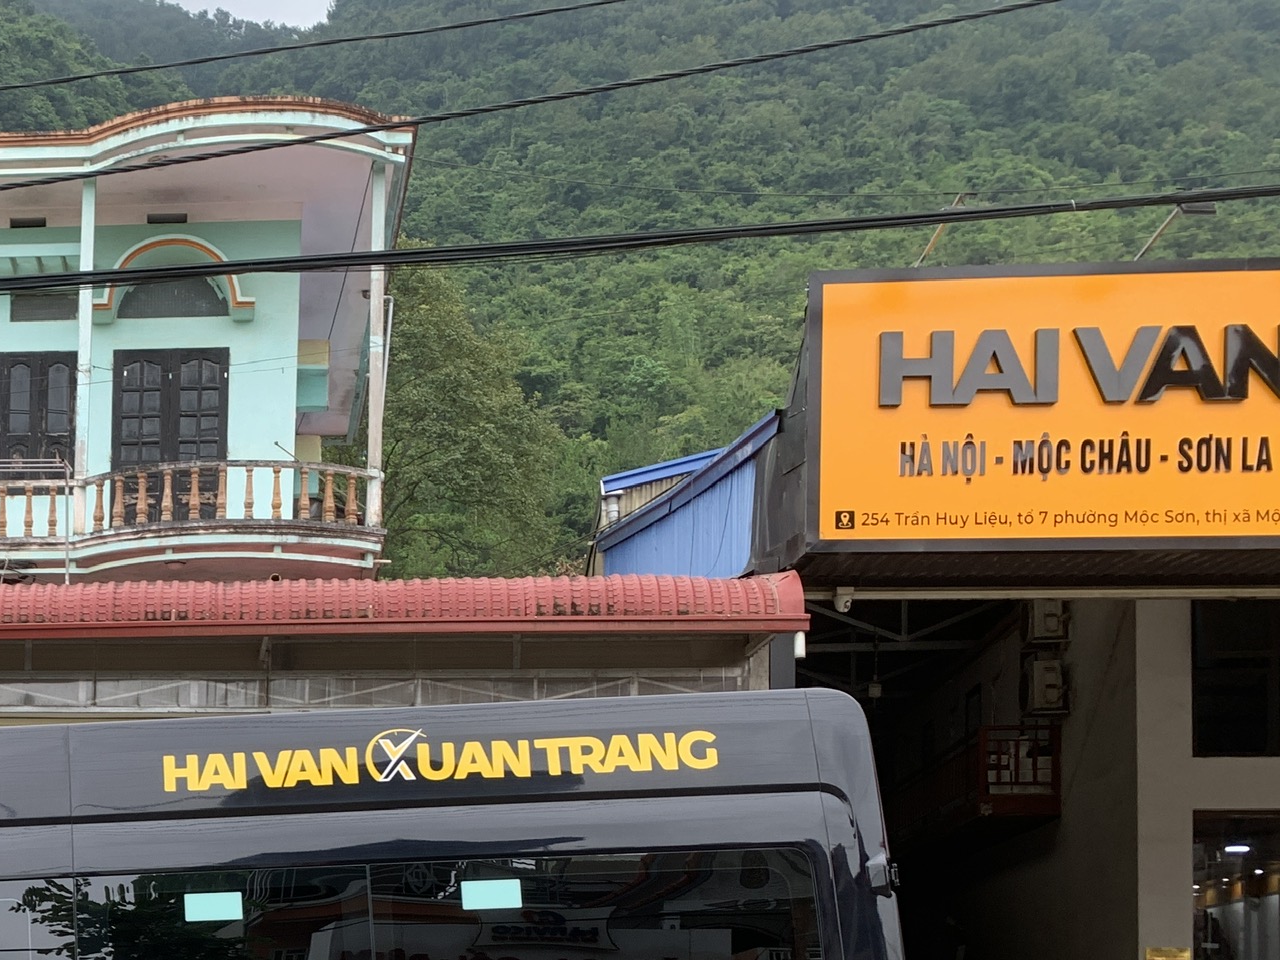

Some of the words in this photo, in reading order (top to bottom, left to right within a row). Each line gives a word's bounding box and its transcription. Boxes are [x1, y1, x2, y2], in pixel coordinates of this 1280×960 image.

[877, 328, 1061, 408] HAI
[1071, 323, 1280, 406] VAN
[899, 434, 933, 476] HÀ
[941, 433, 986, 484] NỘI
[1012, 432, 1072, 481] MỘC
[1080, 431, 1151, 474] CHÂU
[1177, 434, 1233, 473] SƠN
[1241, 436, 1274, 472] LA
[861, 512, 890, 526] 254
[895, 511, 930, 526] Trần
[936, 511, 969, 528] Huy
[974, 511, 1013, 528] Liệu,
[1017, 508, 1034, 525] tổ
[1038, 511, 1049, 525] 7
[1053, 509, 1118, 527] phường
[1124, 510, 1159, 526] Mộc
[1164, 509, 1200, 526] Sơn,
[1205, 509, 1227, 525] thị
[1232, 508, 1251, 523] xã
[163, 754, 246, 792] HAI
[252, 746, 359, 788] VAN
[534, 730, 719, 777] TRANG
